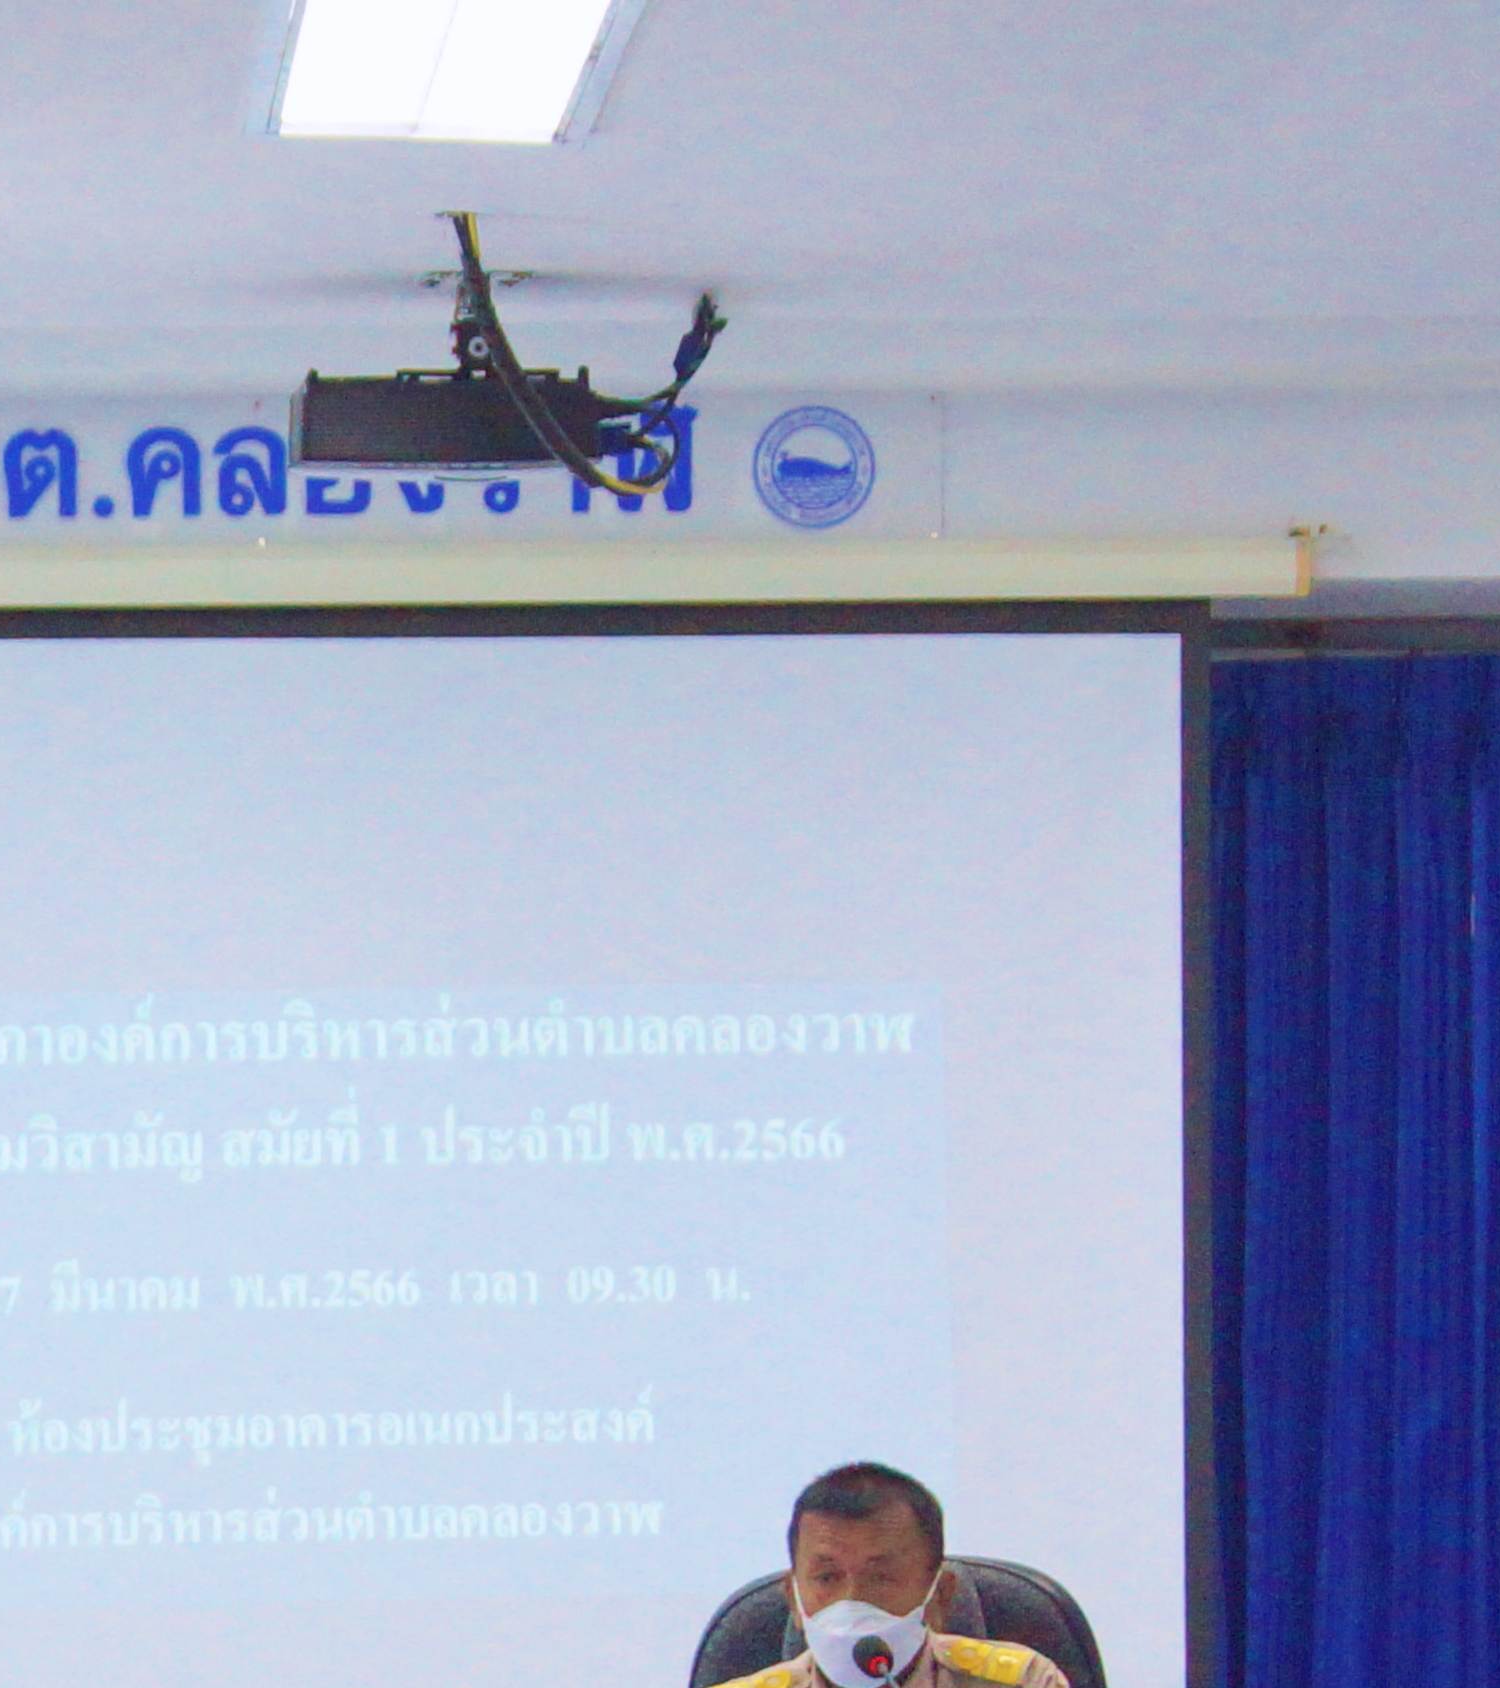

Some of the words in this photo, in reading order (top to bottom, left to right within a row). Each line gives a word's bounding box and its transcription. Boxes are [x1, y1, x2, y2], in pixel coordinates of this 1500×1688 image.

[223, 1088, 360, 1169] สมัยที่
[380, 1122, 398, 1164] 1
[422, 1101, 610, 1166] ประจำปี
[48, 1258, 200, 1313] มีนาคม
[449, 1267, 539, 1306] เวลา
[566, 1264, 677, 1304] 09.30
[705, 1266, 752, 1302] น.
